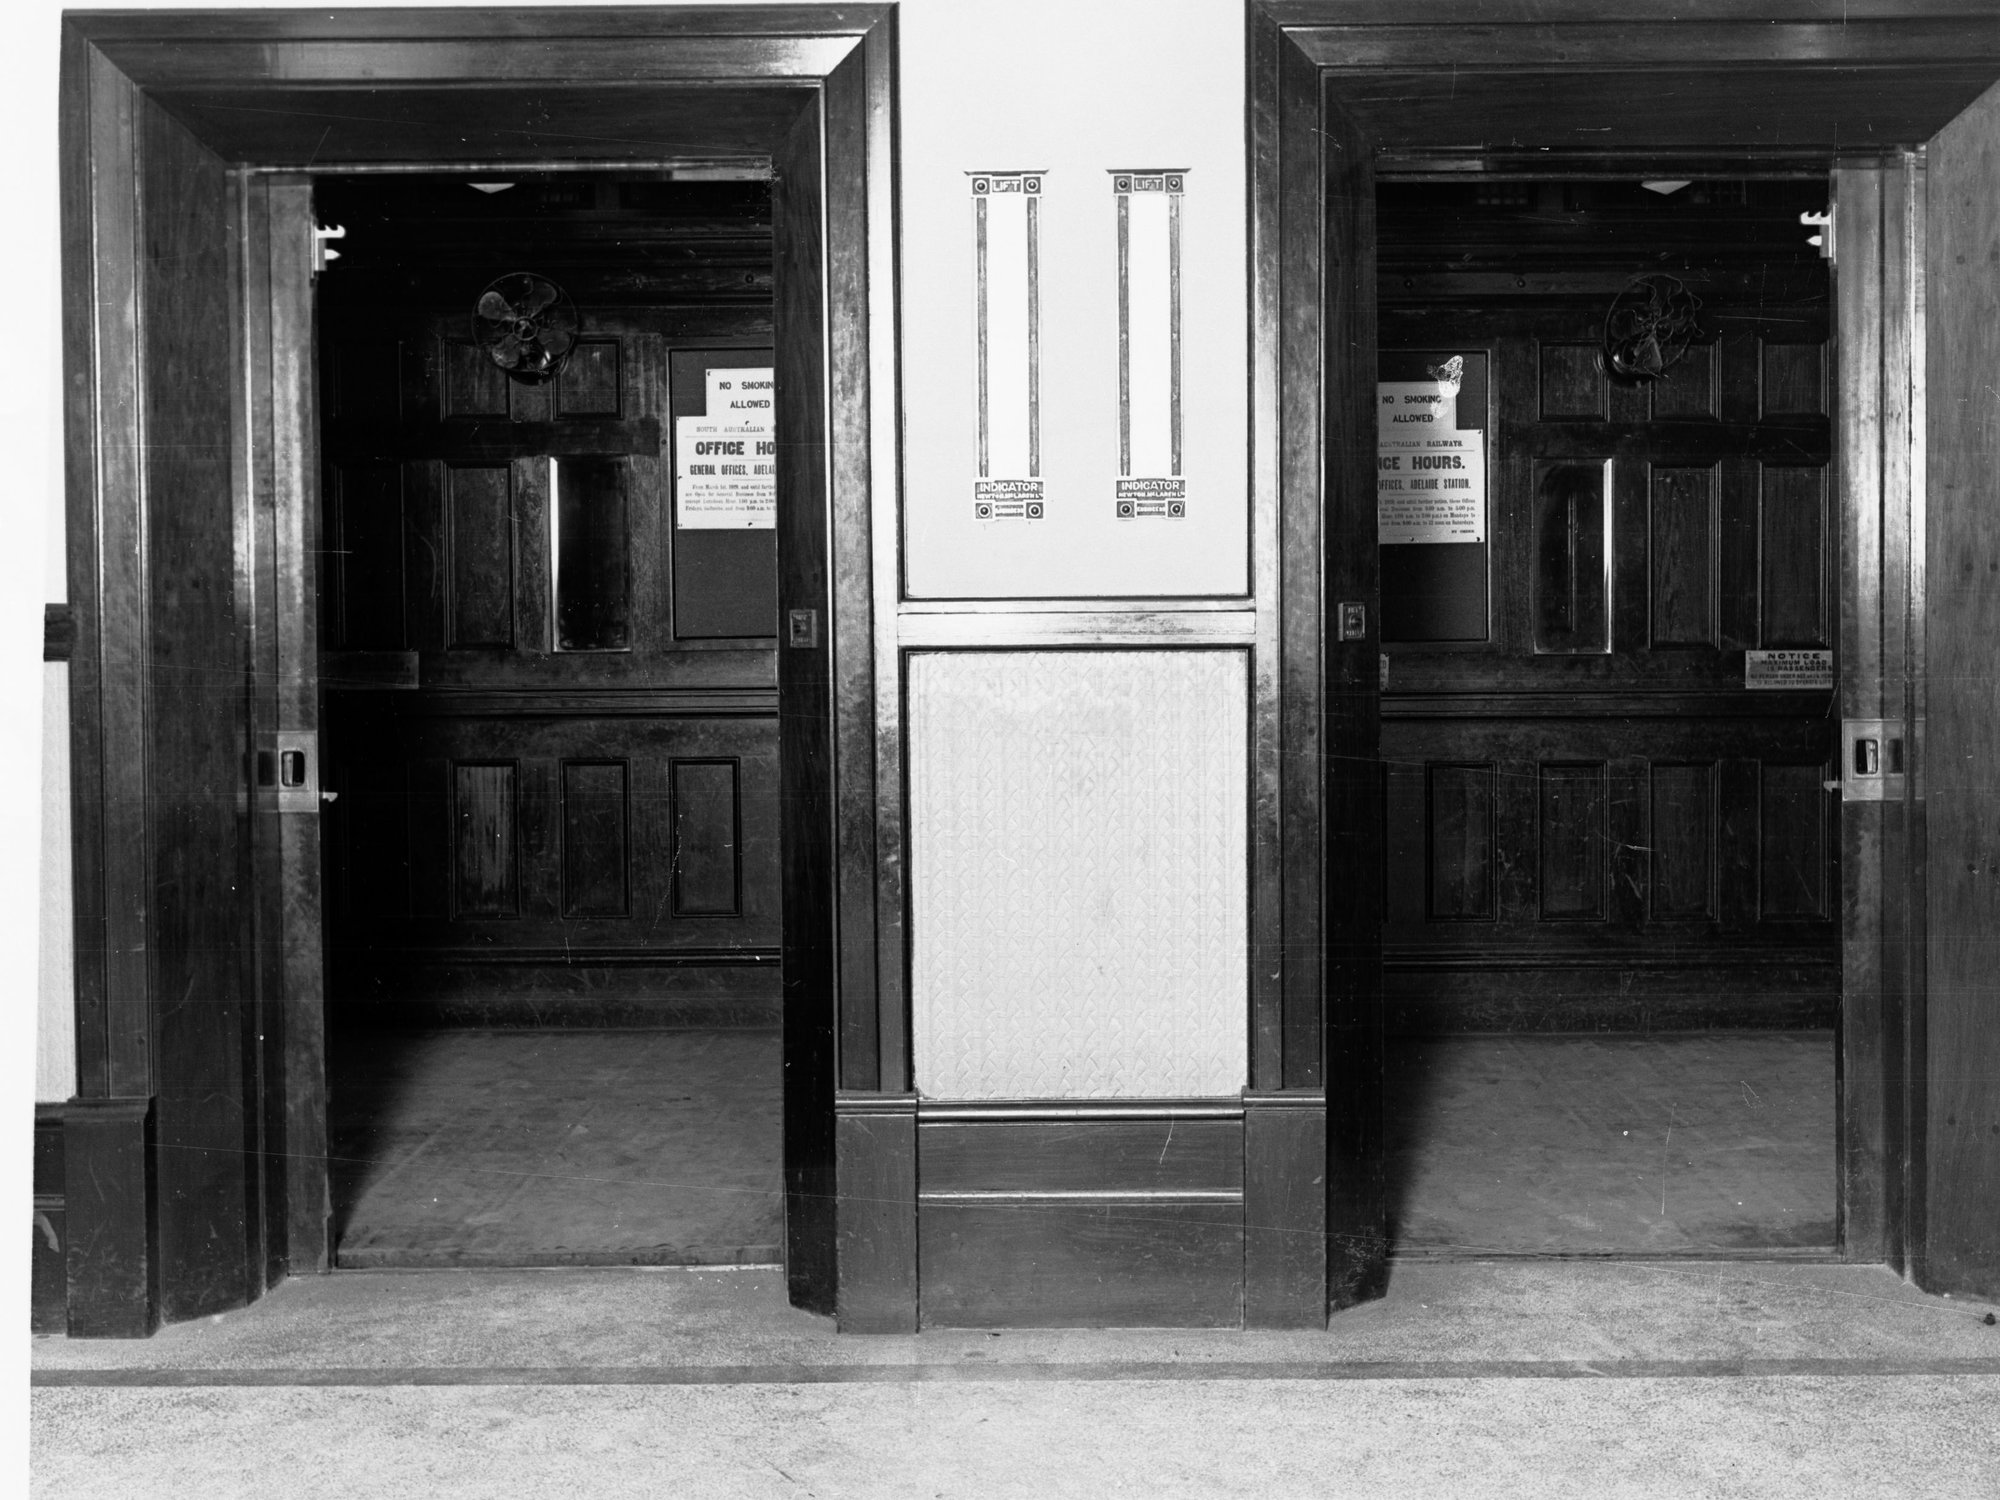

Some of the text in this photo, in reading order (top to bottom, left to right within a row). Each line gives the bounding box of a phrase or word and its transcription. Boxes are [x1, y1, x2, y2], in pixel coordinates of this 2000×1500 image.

[993, 180, 1020, 192] LIFT
[1135, 178, 1162, 191] LIFT
[719, 381, 732, 390] NO
[730, 400, 770, 409] ALLOWED
[1382, 395, 1441, 404] NO SMOKING
[1393, 414, 1433, 423] ALLOWED
[695, 441, 745, 456] OFFICE
[1412, 455, 1465, 470] HOURS.
[690, 464, 716, 476] GENERAL
[980, 482, 1038, 492] INDICATOR
[1121, 481, 1180, 491] INDICATOR
[1410, 478, 1438, 490] ADELAIDE
